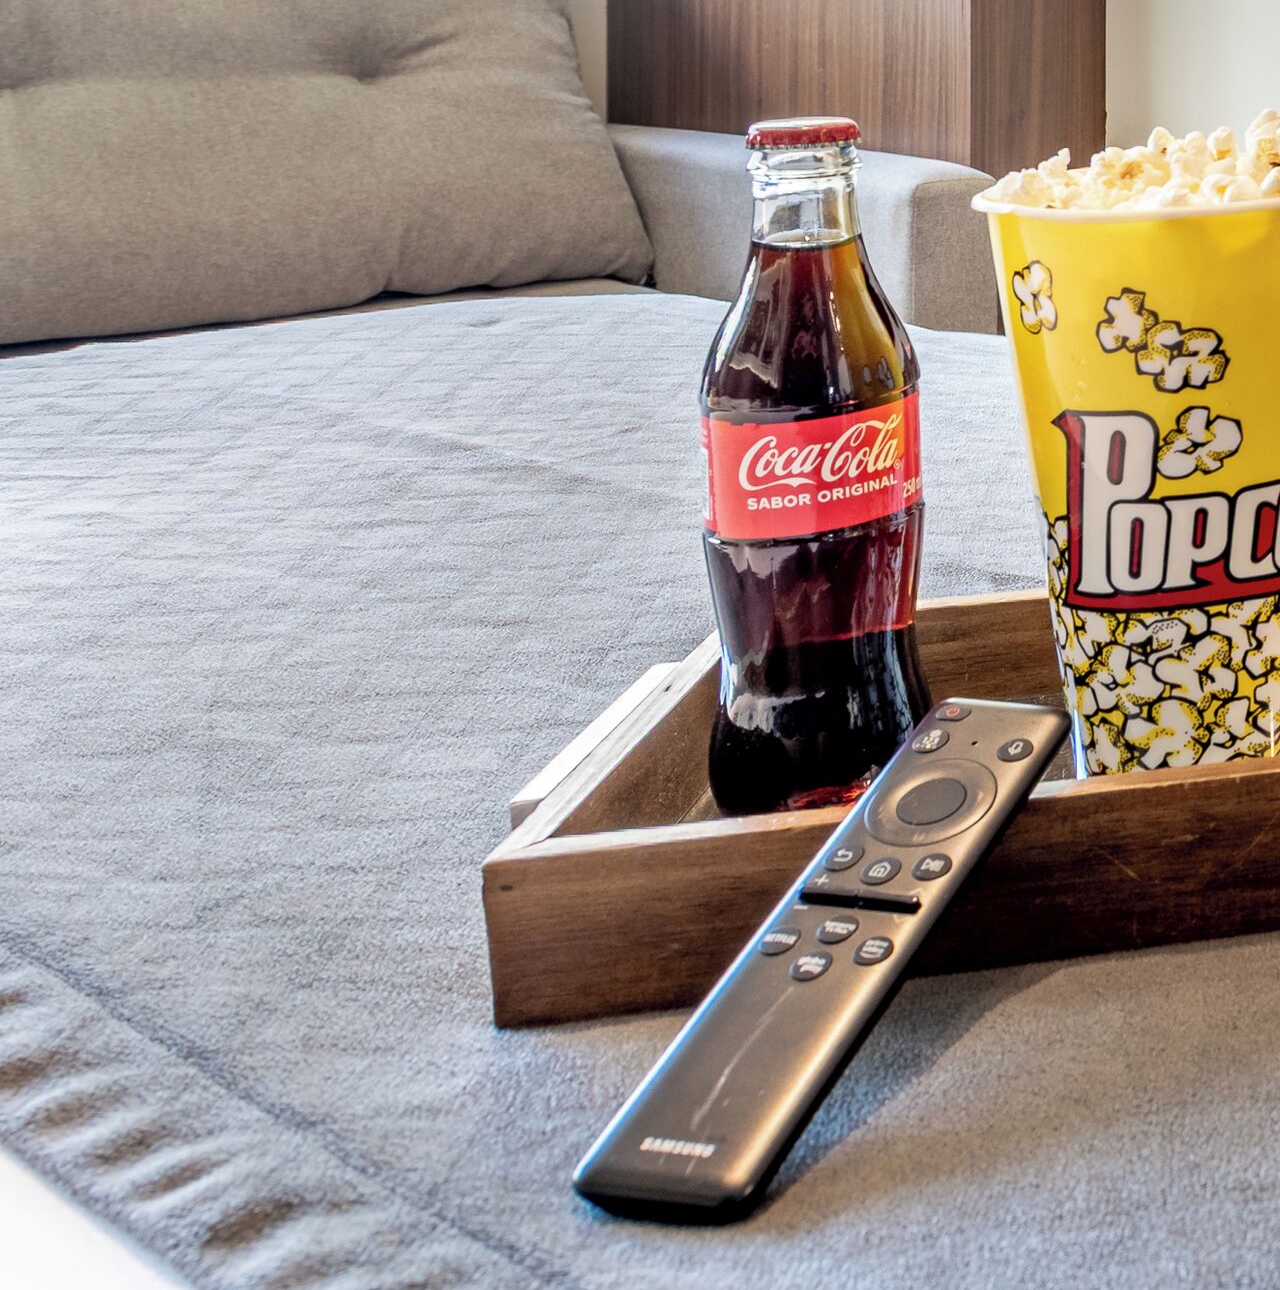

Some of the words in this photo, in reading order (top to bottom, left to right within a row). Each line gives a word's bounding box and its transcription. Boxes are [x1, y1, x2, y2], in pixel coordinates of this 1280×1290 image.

[738, 412, 903, 491] Coca-Cola
[747, 493, 811, 510] SABOR
[817, 473, 898, 503] ORIGINAL
[640, 1136, 716, 1158] SAMSUNG
